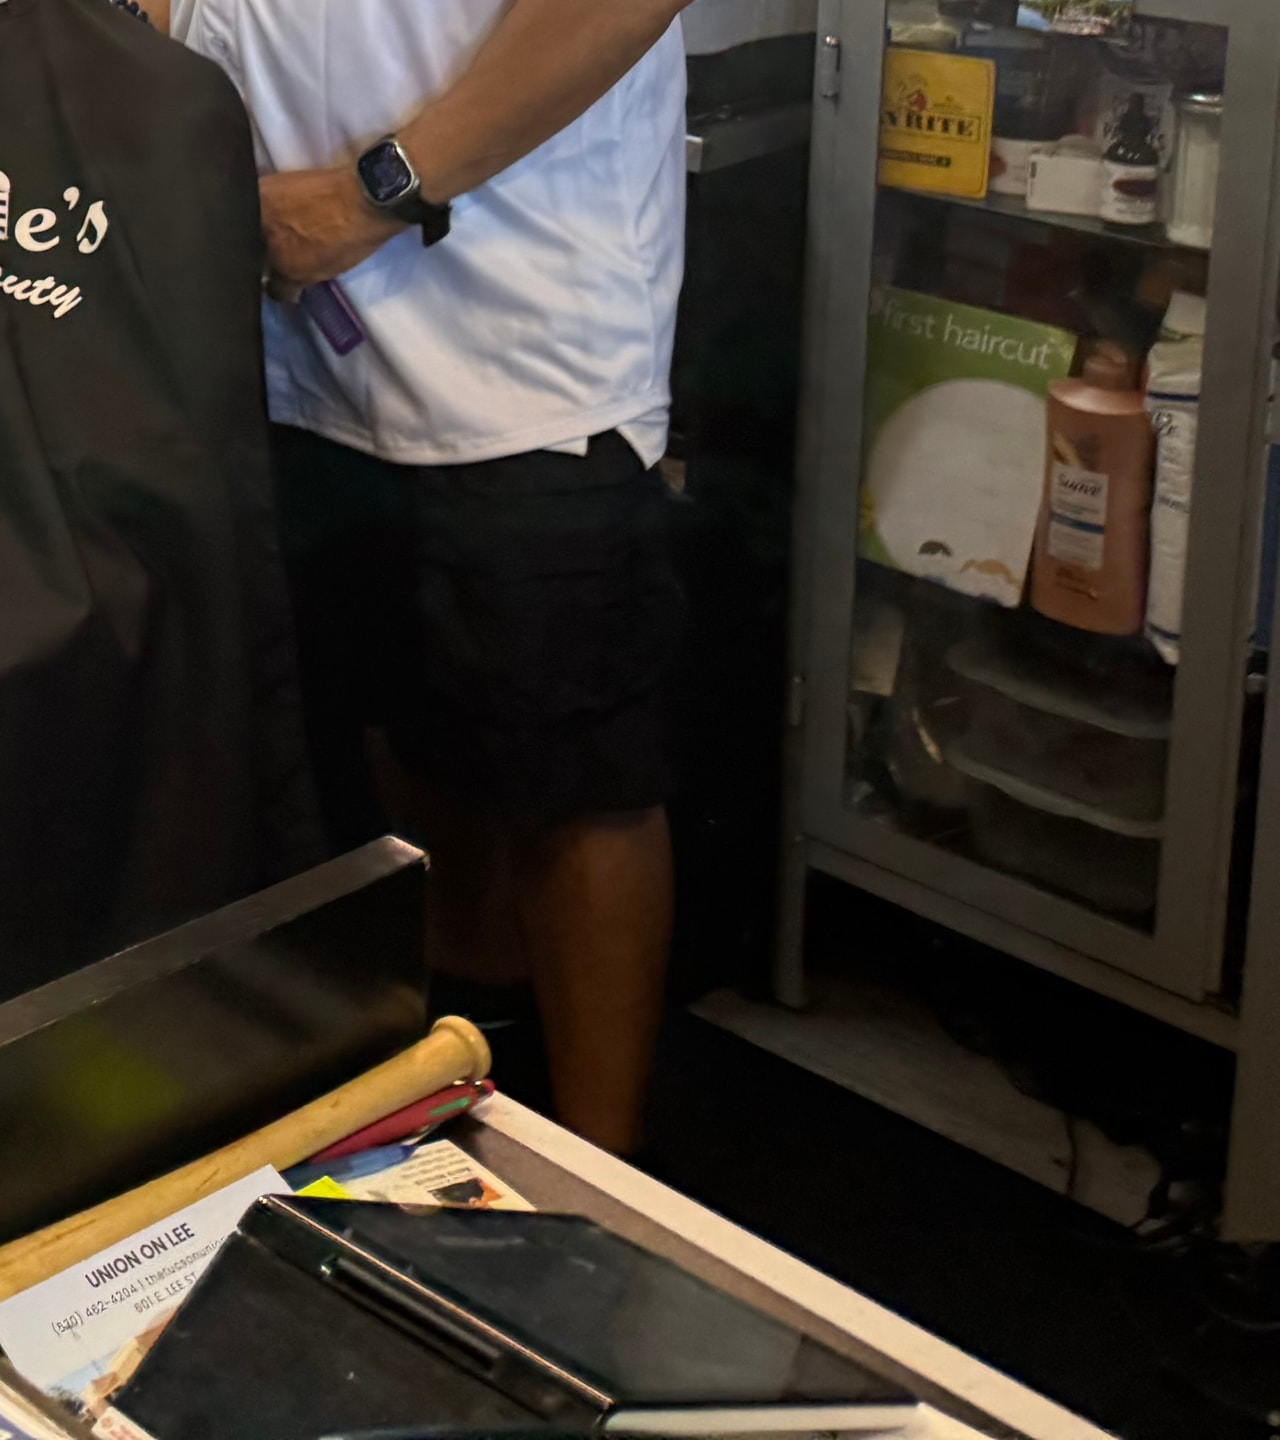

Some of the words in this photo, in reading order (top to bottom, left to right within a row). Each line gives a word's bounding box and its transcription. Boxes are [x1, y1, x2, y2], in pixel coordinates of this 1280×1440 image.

[943, 313, 1049, 370] haircut
[84, 1250, 141, 1289] UNION
[140, 1235, 169, 1260] ON
[165, 1222, 196, 1248] LEE
[165, 1281, 184, 1299] LEE
